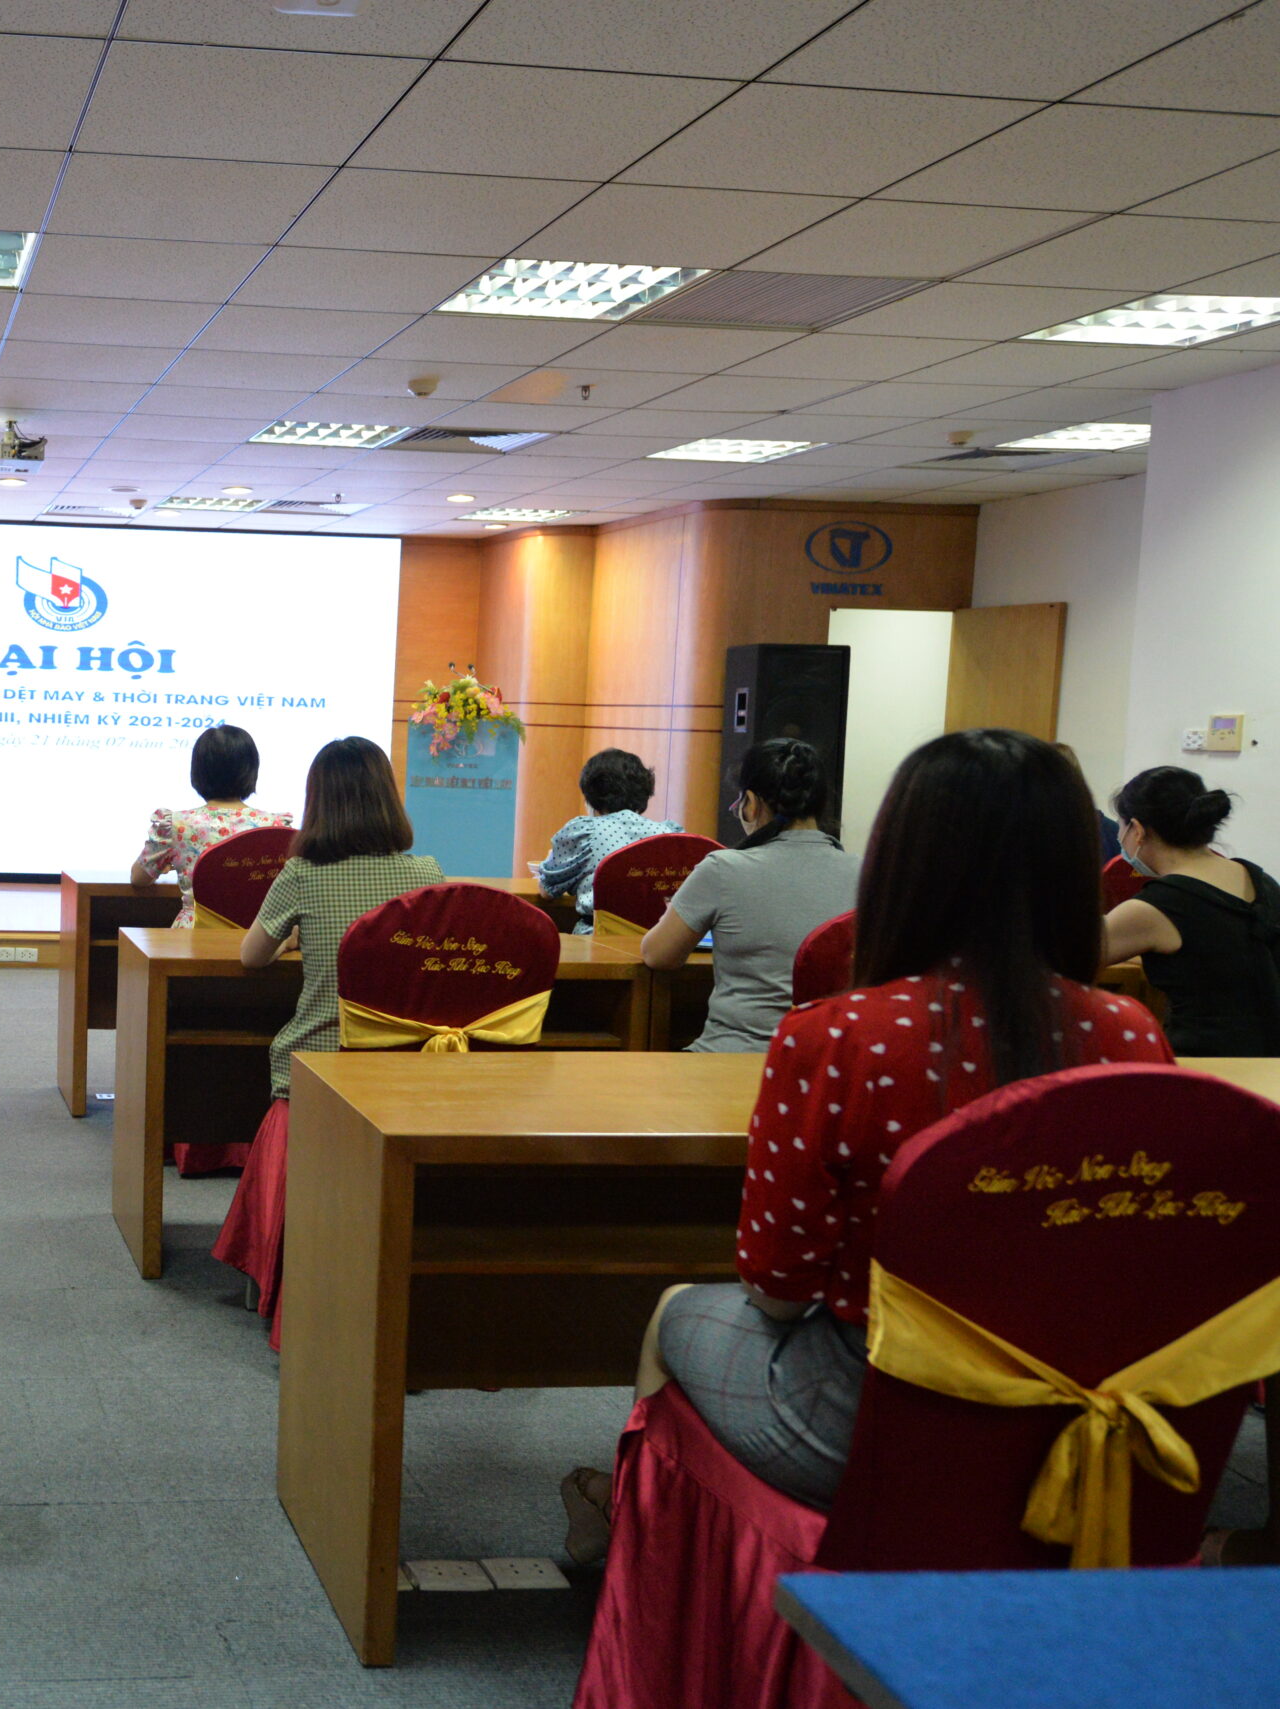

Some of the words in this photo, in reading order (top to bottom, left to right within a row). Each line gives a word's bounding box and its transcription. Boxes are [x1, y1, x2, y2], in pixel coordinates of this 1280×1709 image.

[75, 640, 176, 680] HỘI
[3, 686, 38, 702] DỆT
[44, 690, 85, 701] MAY
[92, 691, 105, 702] &
[112, 690, 158, 704] THỜI
[164, 693, 230, 706] TRANG
[237, 693, 276, 710] VIỆT
[281, 697, 326, 709] NAM
[28, 711, 90, 727] NHIỆM
[97, 711, 123, 726] KỲ
